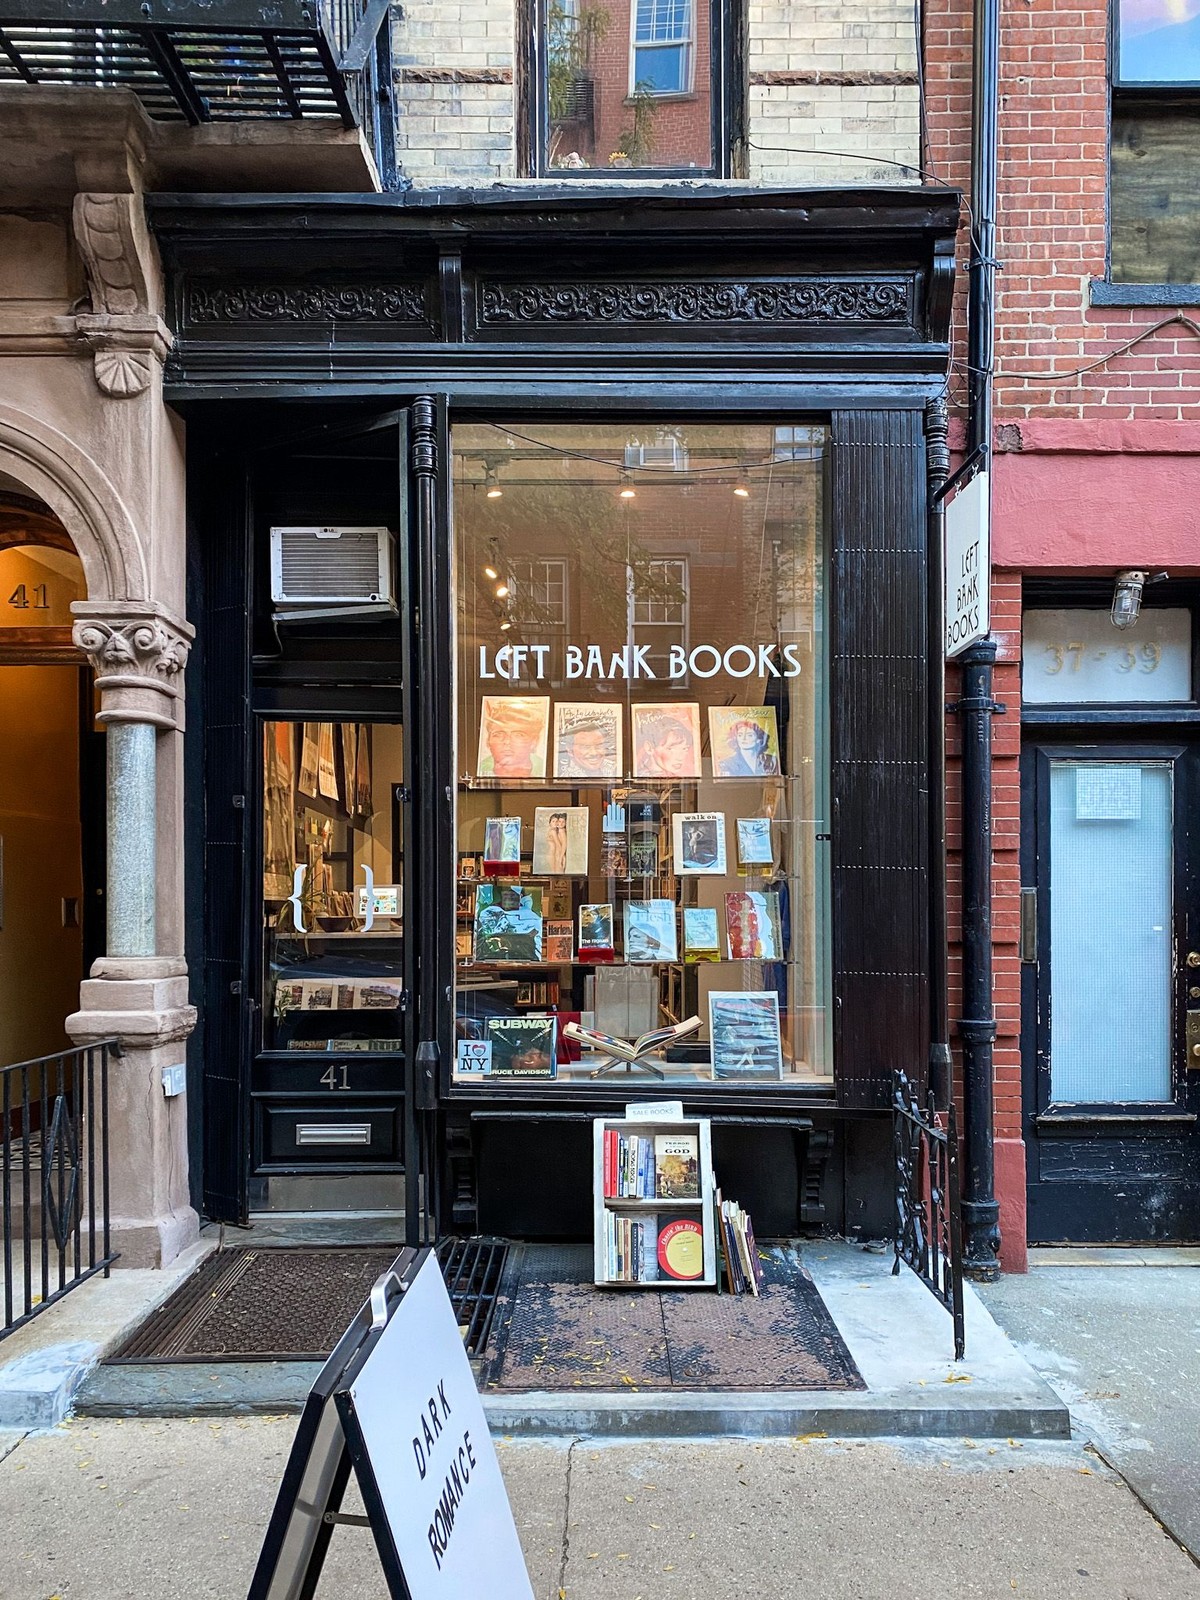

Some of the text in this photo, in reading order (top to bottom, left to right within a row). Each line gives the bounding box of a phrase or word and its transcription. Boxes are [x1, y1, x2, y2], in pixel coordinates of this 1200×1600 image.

[962, 540, 980, 579] LEFT
[8, 583, 50, 609] 41
[956, 573, 980, 613] BANK
[947, 603, 980, 650] BOOKS
[479, 644, 802, 679] LEFT BANK BOOKS
[488, 1019, 554, 1029] SUBWAY
[460, 1058, 489, 1070] NY
[463, 1044, 471, 1056] I
[320, 1065, 351, 1090] 41
[411, 1378, 452, 1481] DARK
[426, 1429, 477, 1572] ROMANCE
